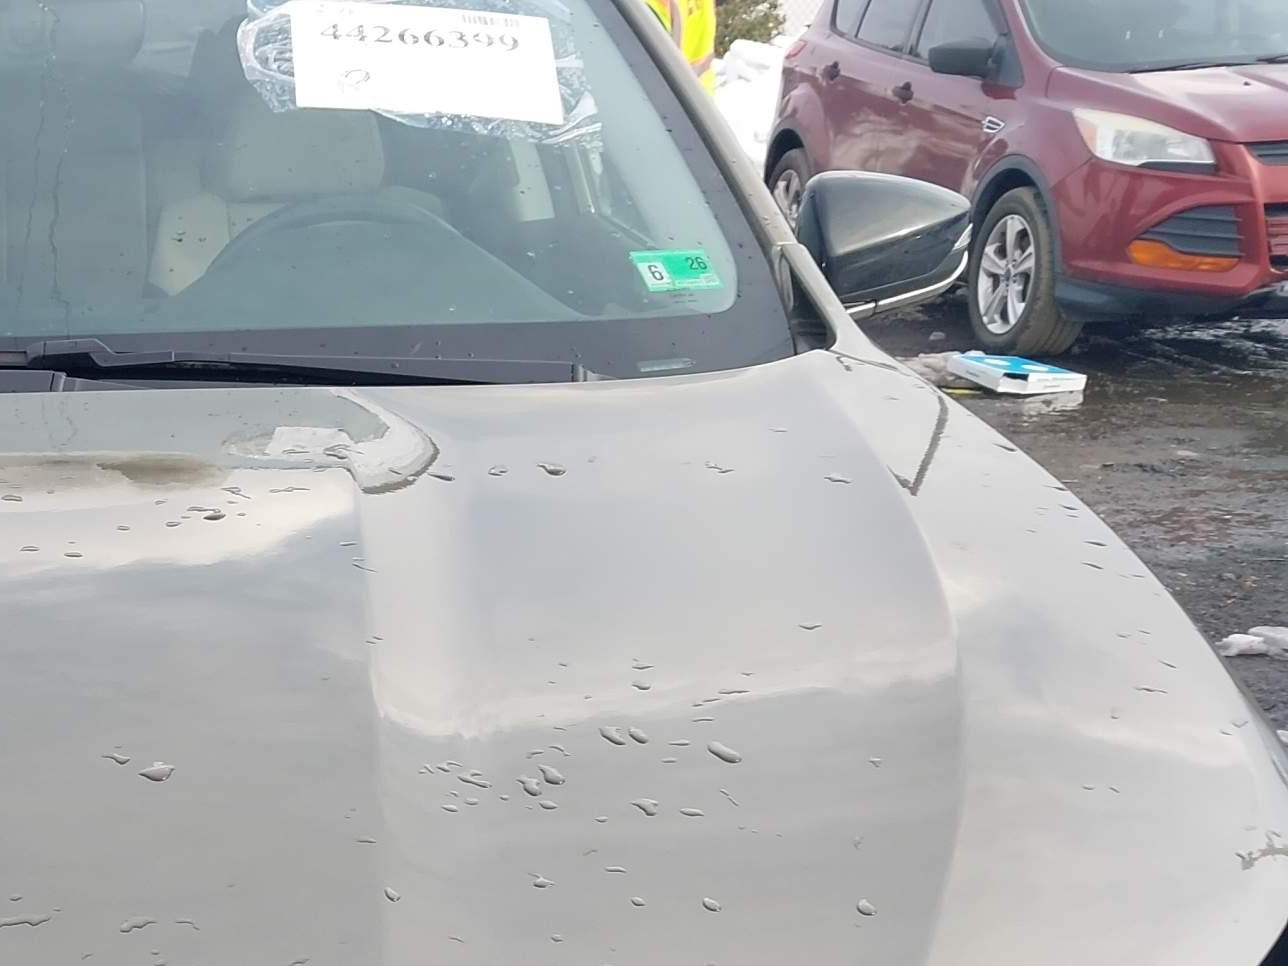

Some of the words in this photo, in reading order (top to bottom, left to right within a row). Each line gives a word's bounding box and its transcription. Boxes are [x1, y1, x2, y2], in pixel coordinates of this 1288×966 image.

[319, 22, 520, 52] 44266399
[685, 256, 708, 271] 26
[647, 264, 664, 281] 6
